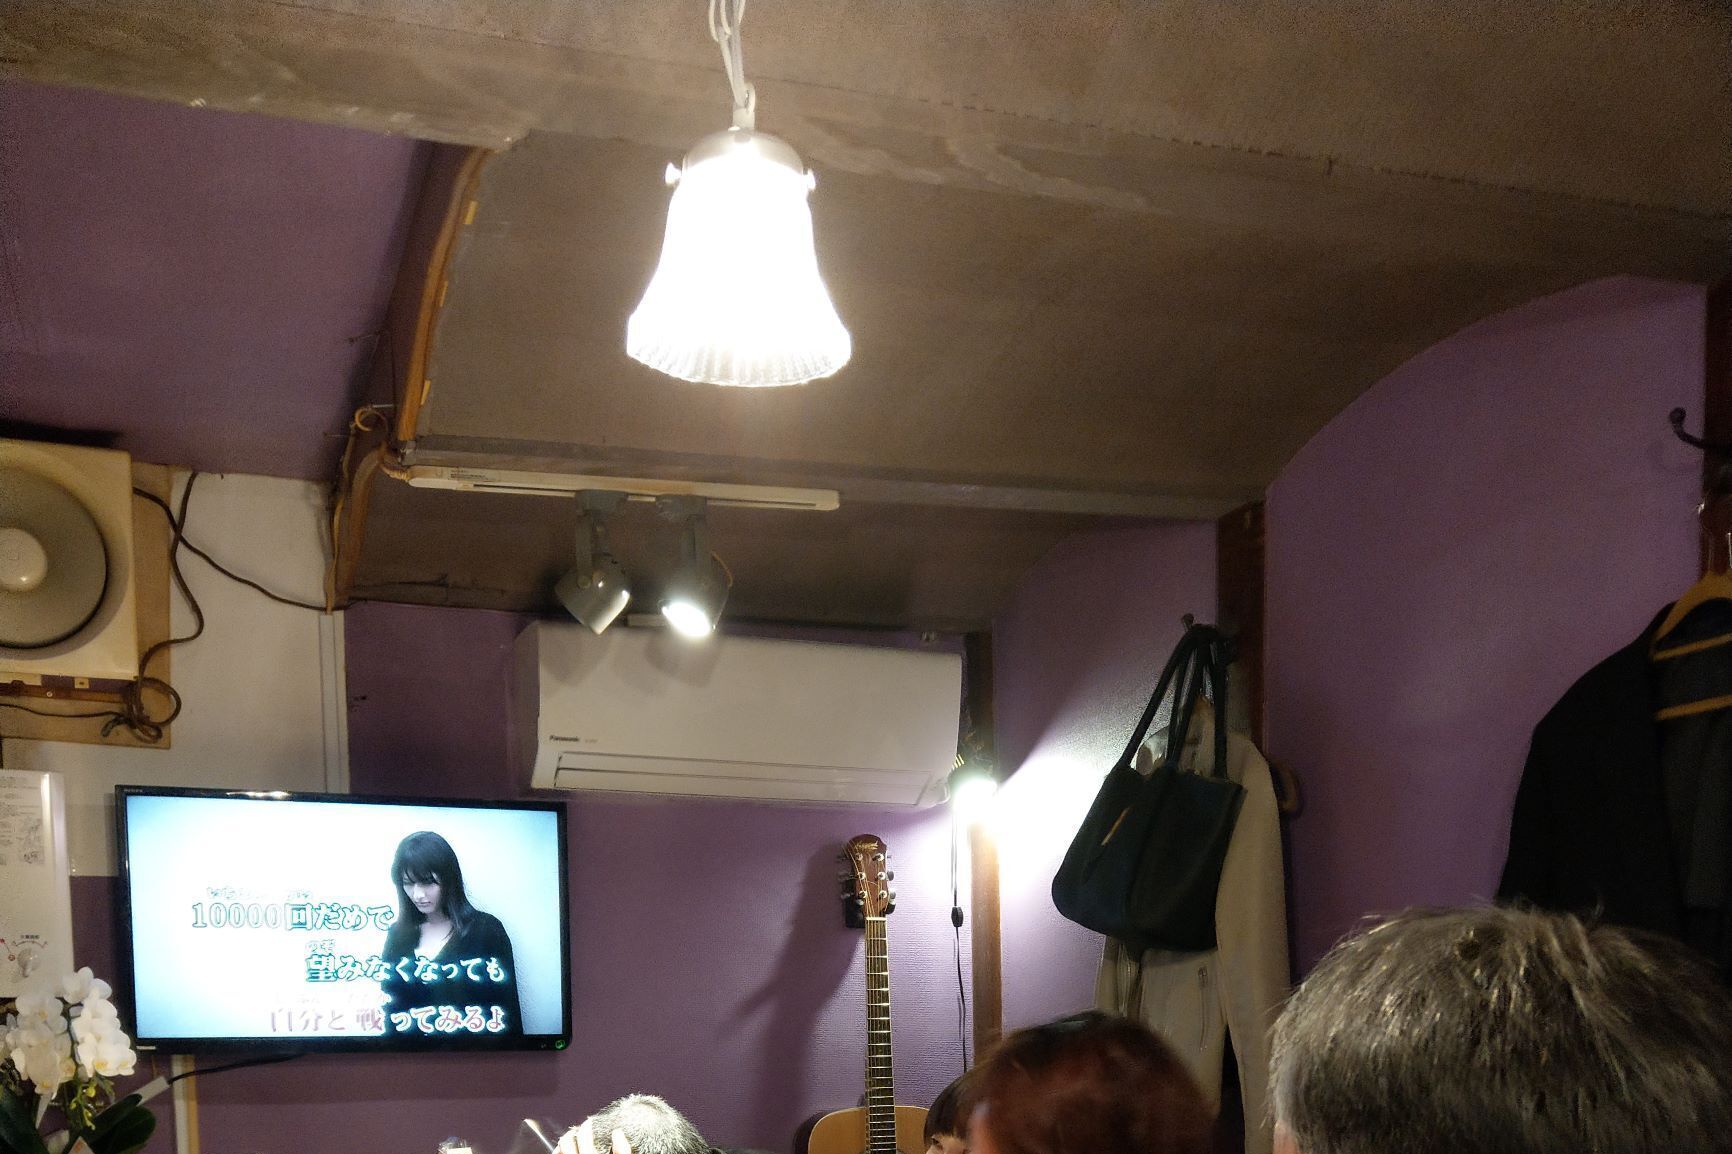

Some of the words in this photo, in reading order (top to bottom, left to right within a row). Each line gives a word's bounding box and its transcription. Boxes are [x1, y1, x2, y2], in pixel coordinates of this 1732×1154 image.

[192, 902, 394, 931] 10000回だめで
[305, 953, 505, 983] 望みなくなっても
